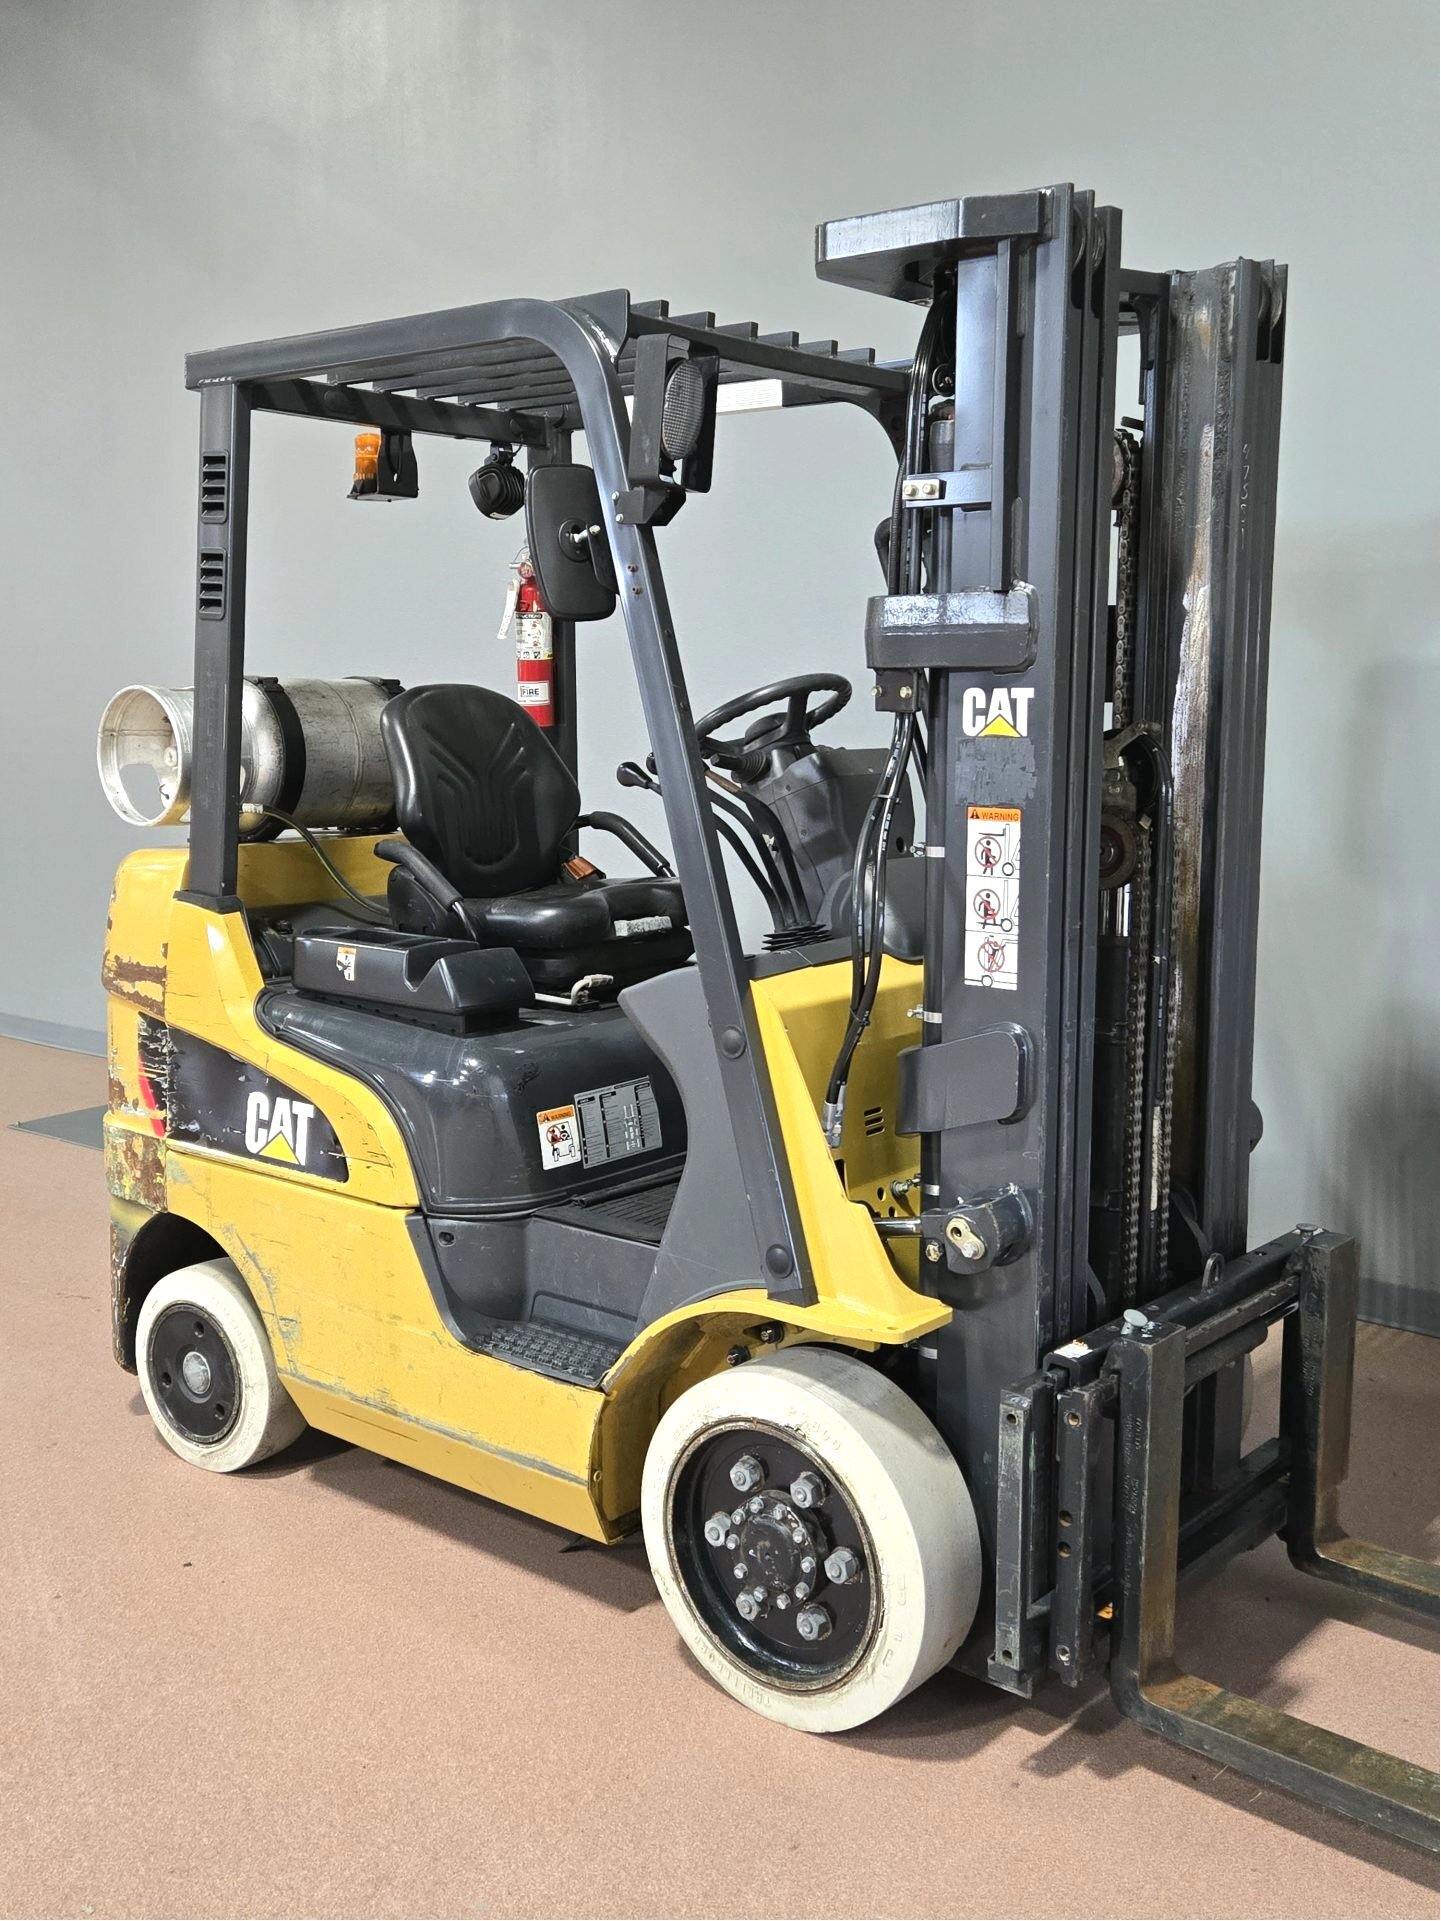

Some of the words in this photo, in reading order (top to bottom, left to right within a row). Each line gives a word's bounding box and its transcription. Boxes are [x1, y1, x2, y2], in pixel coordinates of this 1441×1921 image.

[522, 688, 540, 696] FIRE
[962, 687, 1035, 737] CAT
[981, 811, 1019, 822] WARNING
[245, 1091, 314, 1166] CAT
